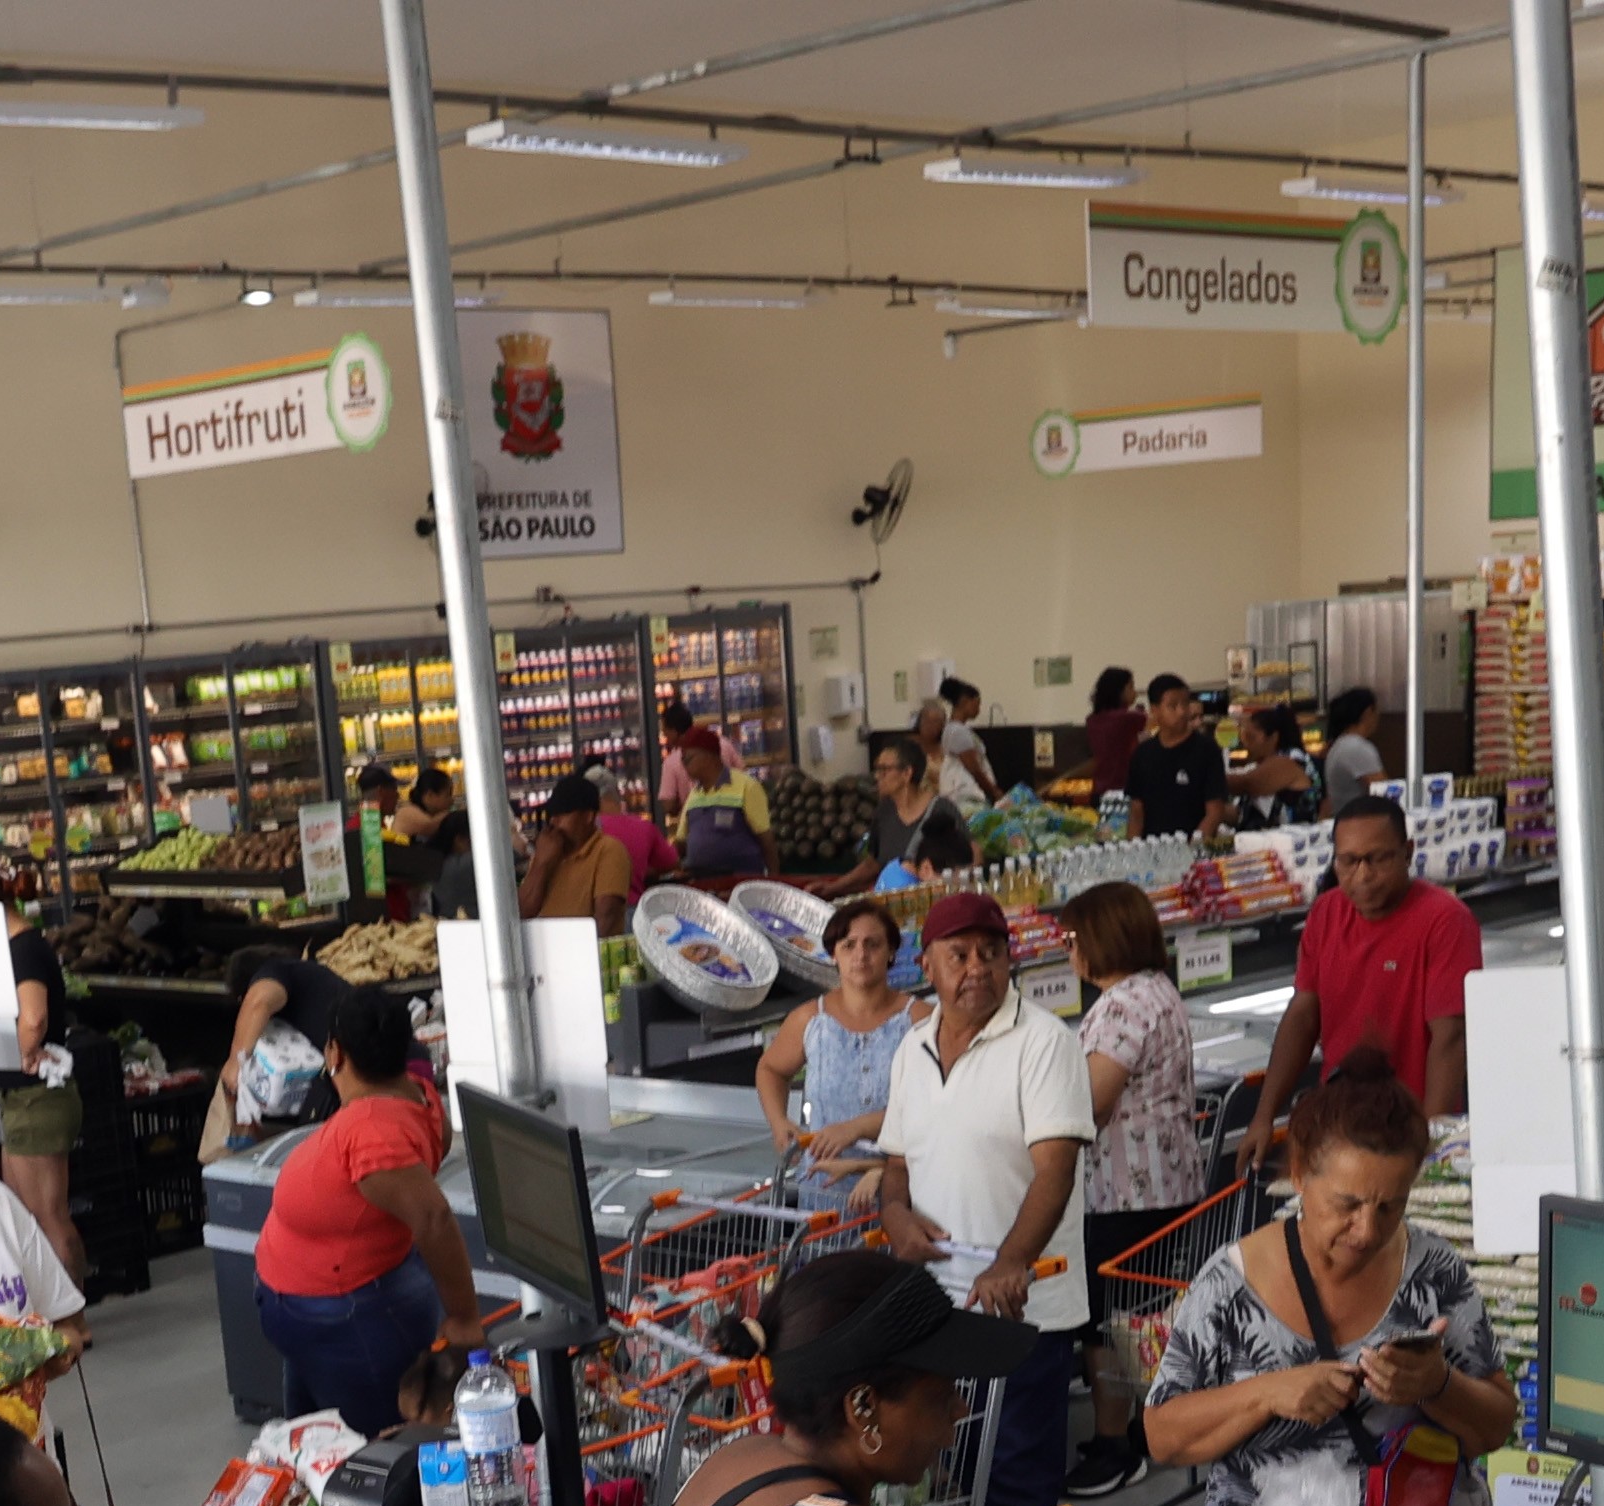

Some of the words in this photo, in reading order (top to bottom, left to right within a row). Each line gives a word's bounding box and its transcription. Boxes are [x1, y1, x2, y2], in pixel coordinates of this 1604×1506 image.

[1123, 252, 1298, 314] Congelados
[146, 387, 307, 461] Hortifruti
[1122, 424, 1208, 456] Padaria
[573, 488, 592, 507] DE
[527, 514, 595, 540] PAULO
